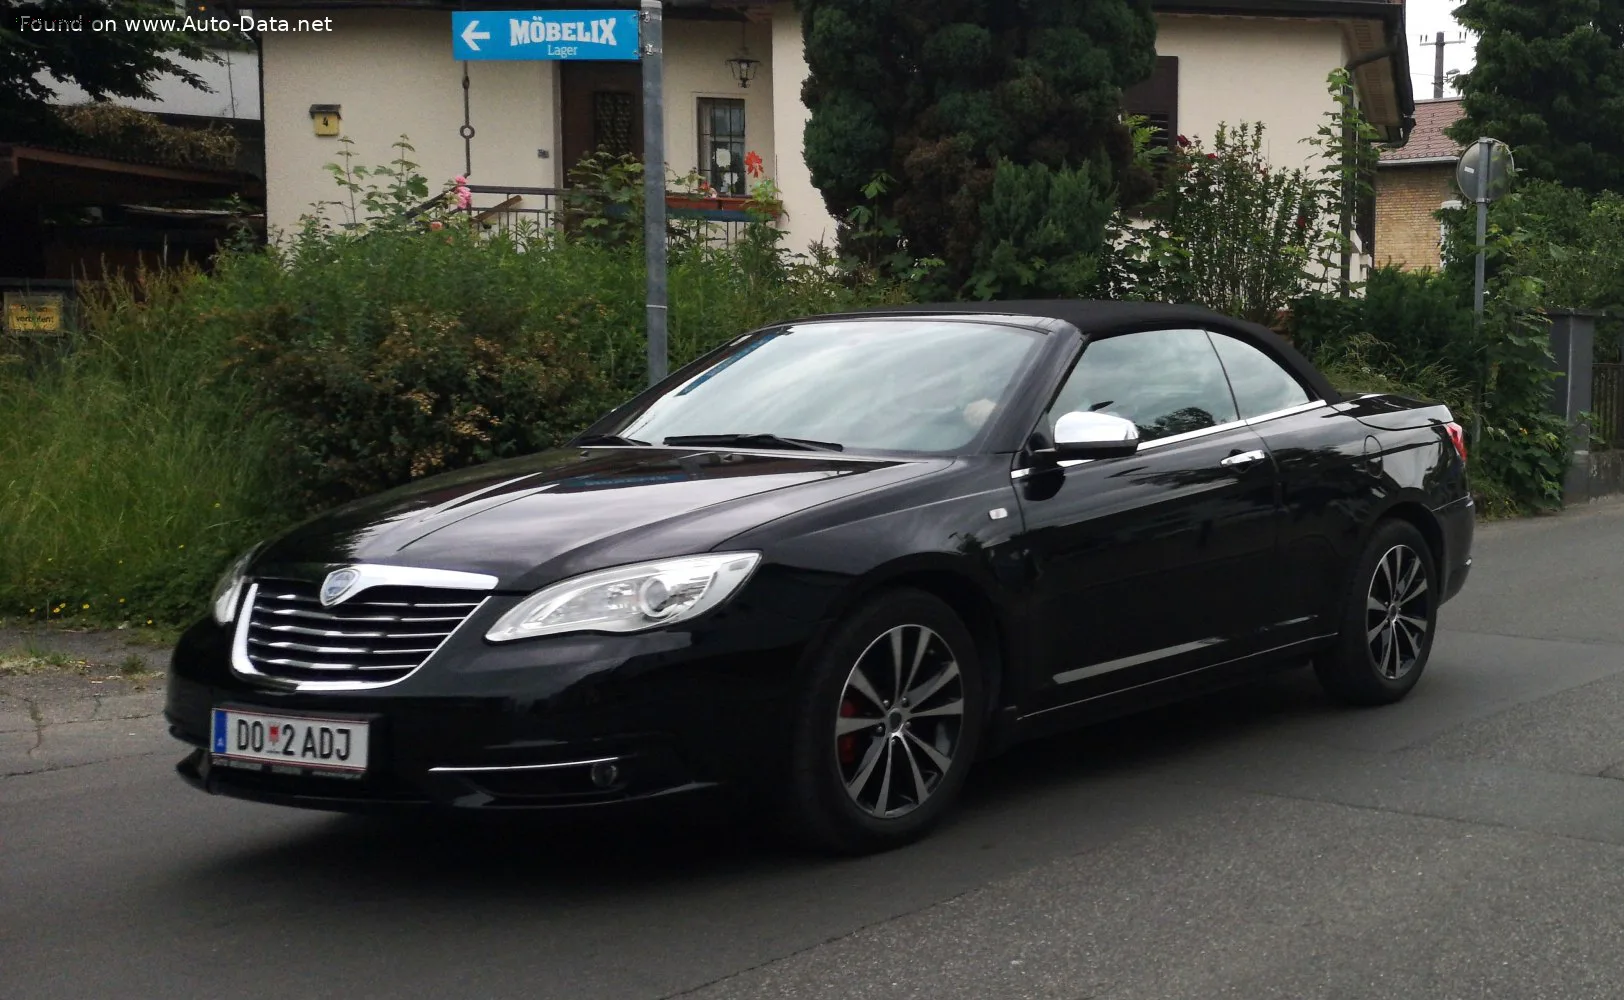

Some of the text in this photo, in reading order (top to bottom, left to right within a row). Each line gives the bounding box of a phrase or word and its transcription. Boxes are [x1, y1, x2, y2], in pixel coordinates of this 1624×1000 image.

[509, 15, 618, 46] MÖBELIX
[547, 45, 578, 59] Lager
[322, 116, 329, 127] 4
[237, 718, 351, 761] DO 2 ADJ
